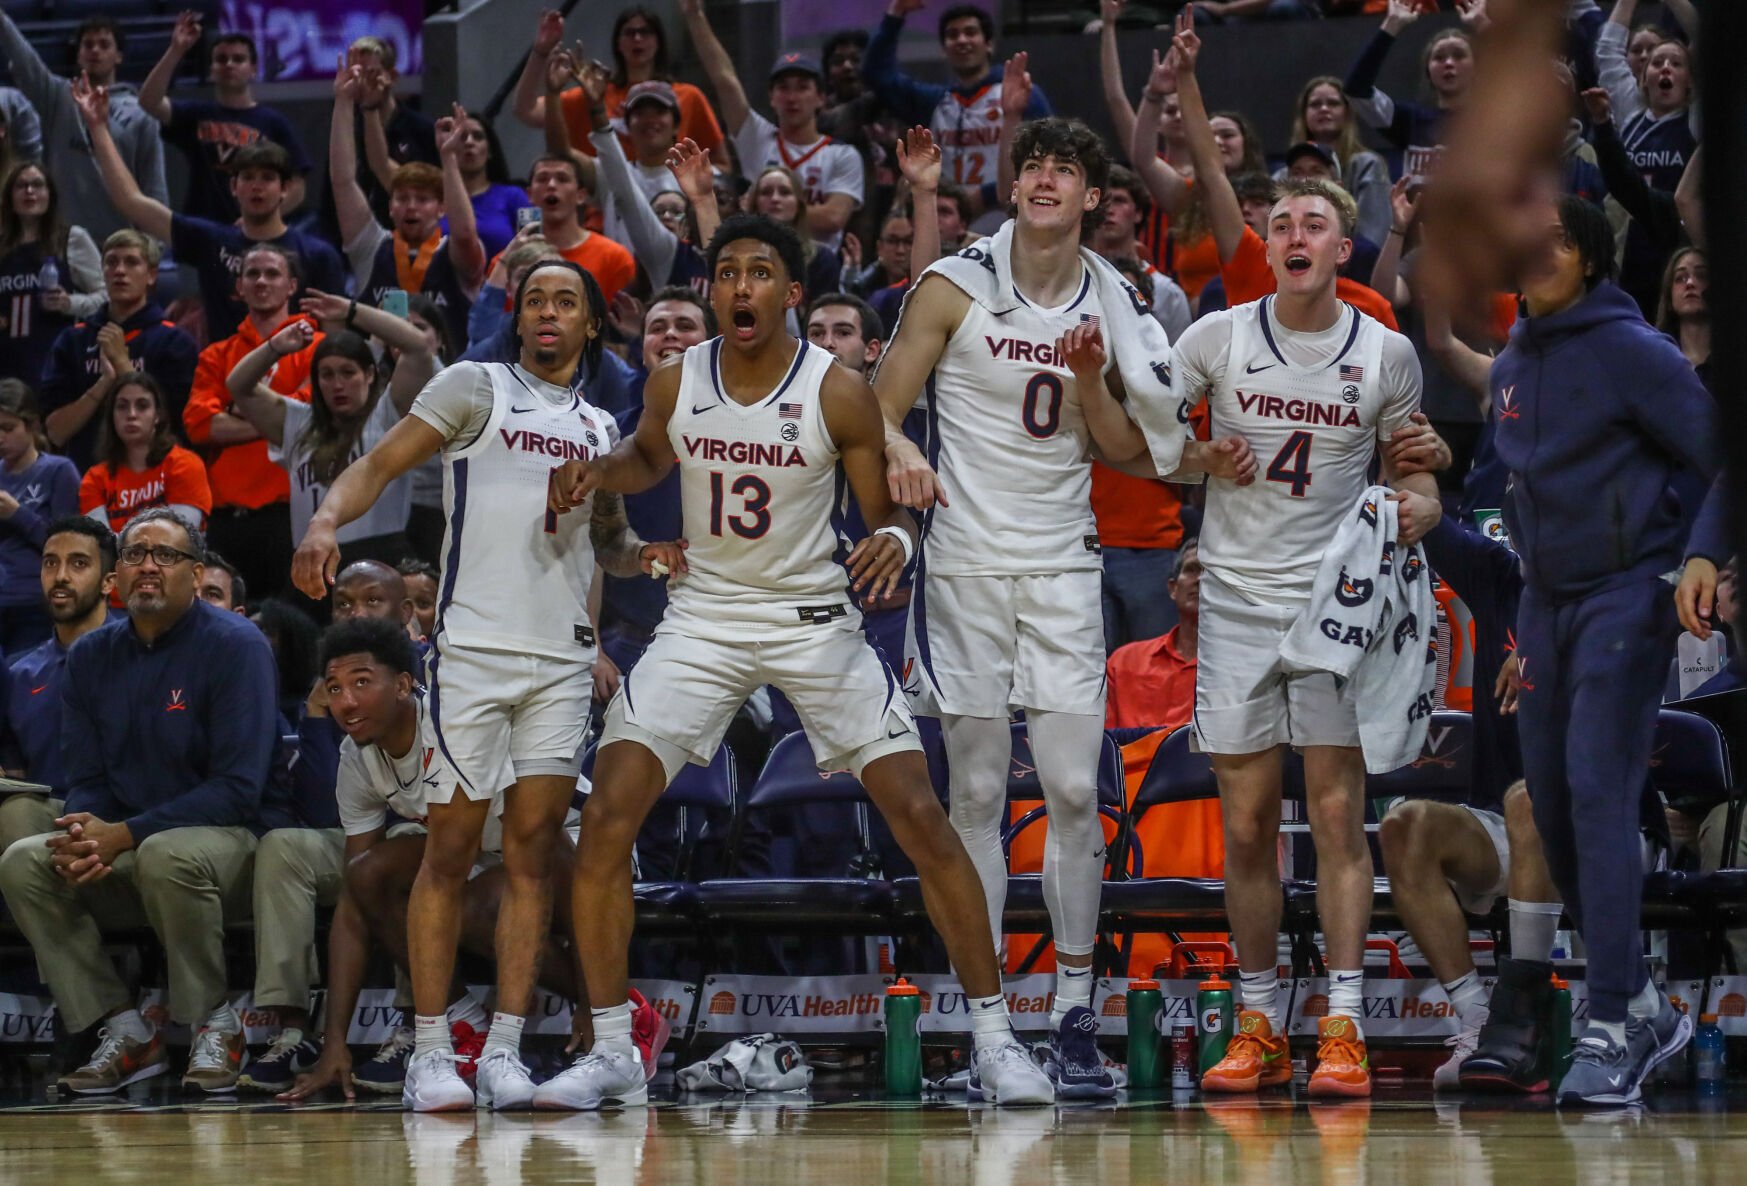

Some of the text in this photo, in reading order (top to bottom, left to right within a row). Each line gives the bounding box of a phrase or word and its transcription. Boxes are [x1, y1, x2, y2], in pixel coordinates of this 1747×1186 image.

[954, 152, 984, 185] 12
[9, 293, 32, 339] 11
[1022, 371, 1064, 439] 0
[1236, 390, 1361, 427] VIRGINIA
[682, 435, 808, 467] VIRGINIA
[1266, 430, 1314, 497] 4
[710, 471, 771, 540] 13
[741, 993, 880, 1017] UVA Health
